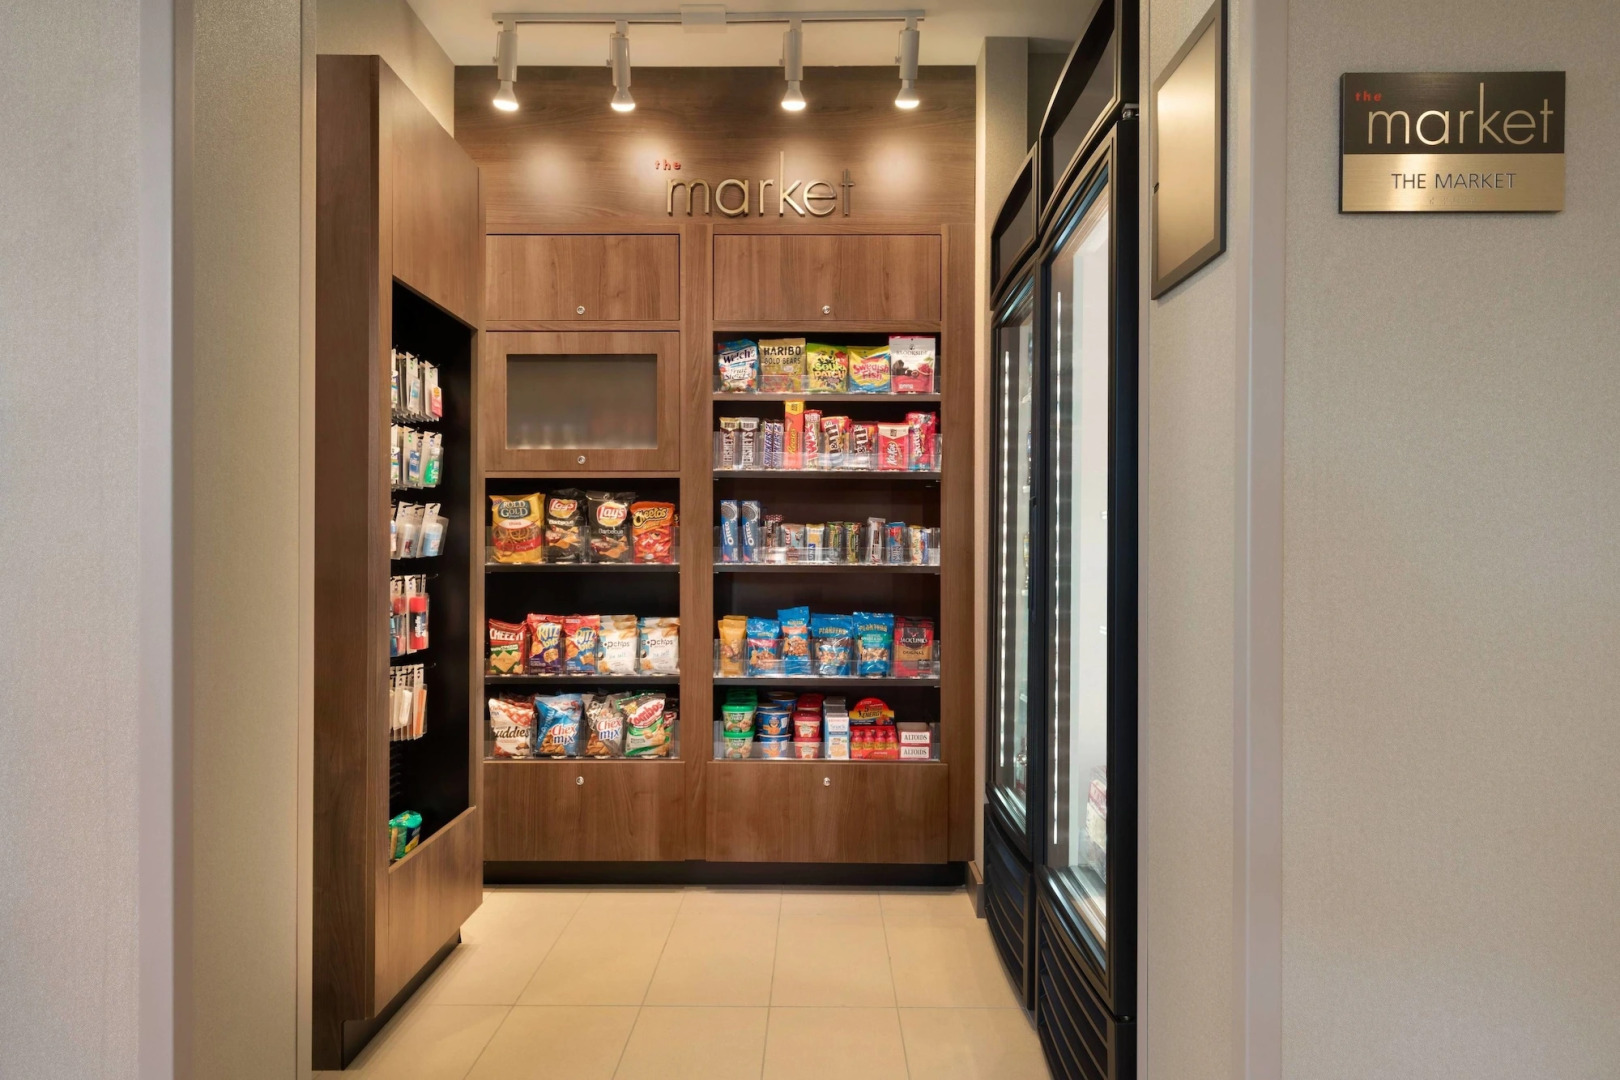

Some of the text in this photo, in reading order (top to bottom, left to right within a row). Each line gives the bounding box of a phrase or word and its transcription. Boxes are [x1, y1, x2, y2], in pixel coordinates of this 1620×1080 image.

[1355, 91, 1382, 102] the
[1368, 82, 1554, 146] market
[655, 159, 681, 170] the
[667, 151, 855, 217] market
[1391, 173, 1517, 189] THE MARKET
[763, 346, 802, 356] HARIBO
[814, 363, 844, 371] SOUR
[853, 364, 889, 374] Swedish
[862, 371, 883, 380] Fish
[503, 501, 525, 509] ROLD
[500, 508, 528, 517] GOLD
[633, 508, 667, 526] Cheetos
[724, 521, 734, 546] OREO
[745, 521, 755, 546] OREO
[538, 626, 560, 641] RITZ
[576, 629, 596, 644] RITZ
[551, 726, 576, 736] Chex
[597, 720, 621, 731] Chex
[600, 729, 620, 740] mix
[553, 736, 575, 745] mix
